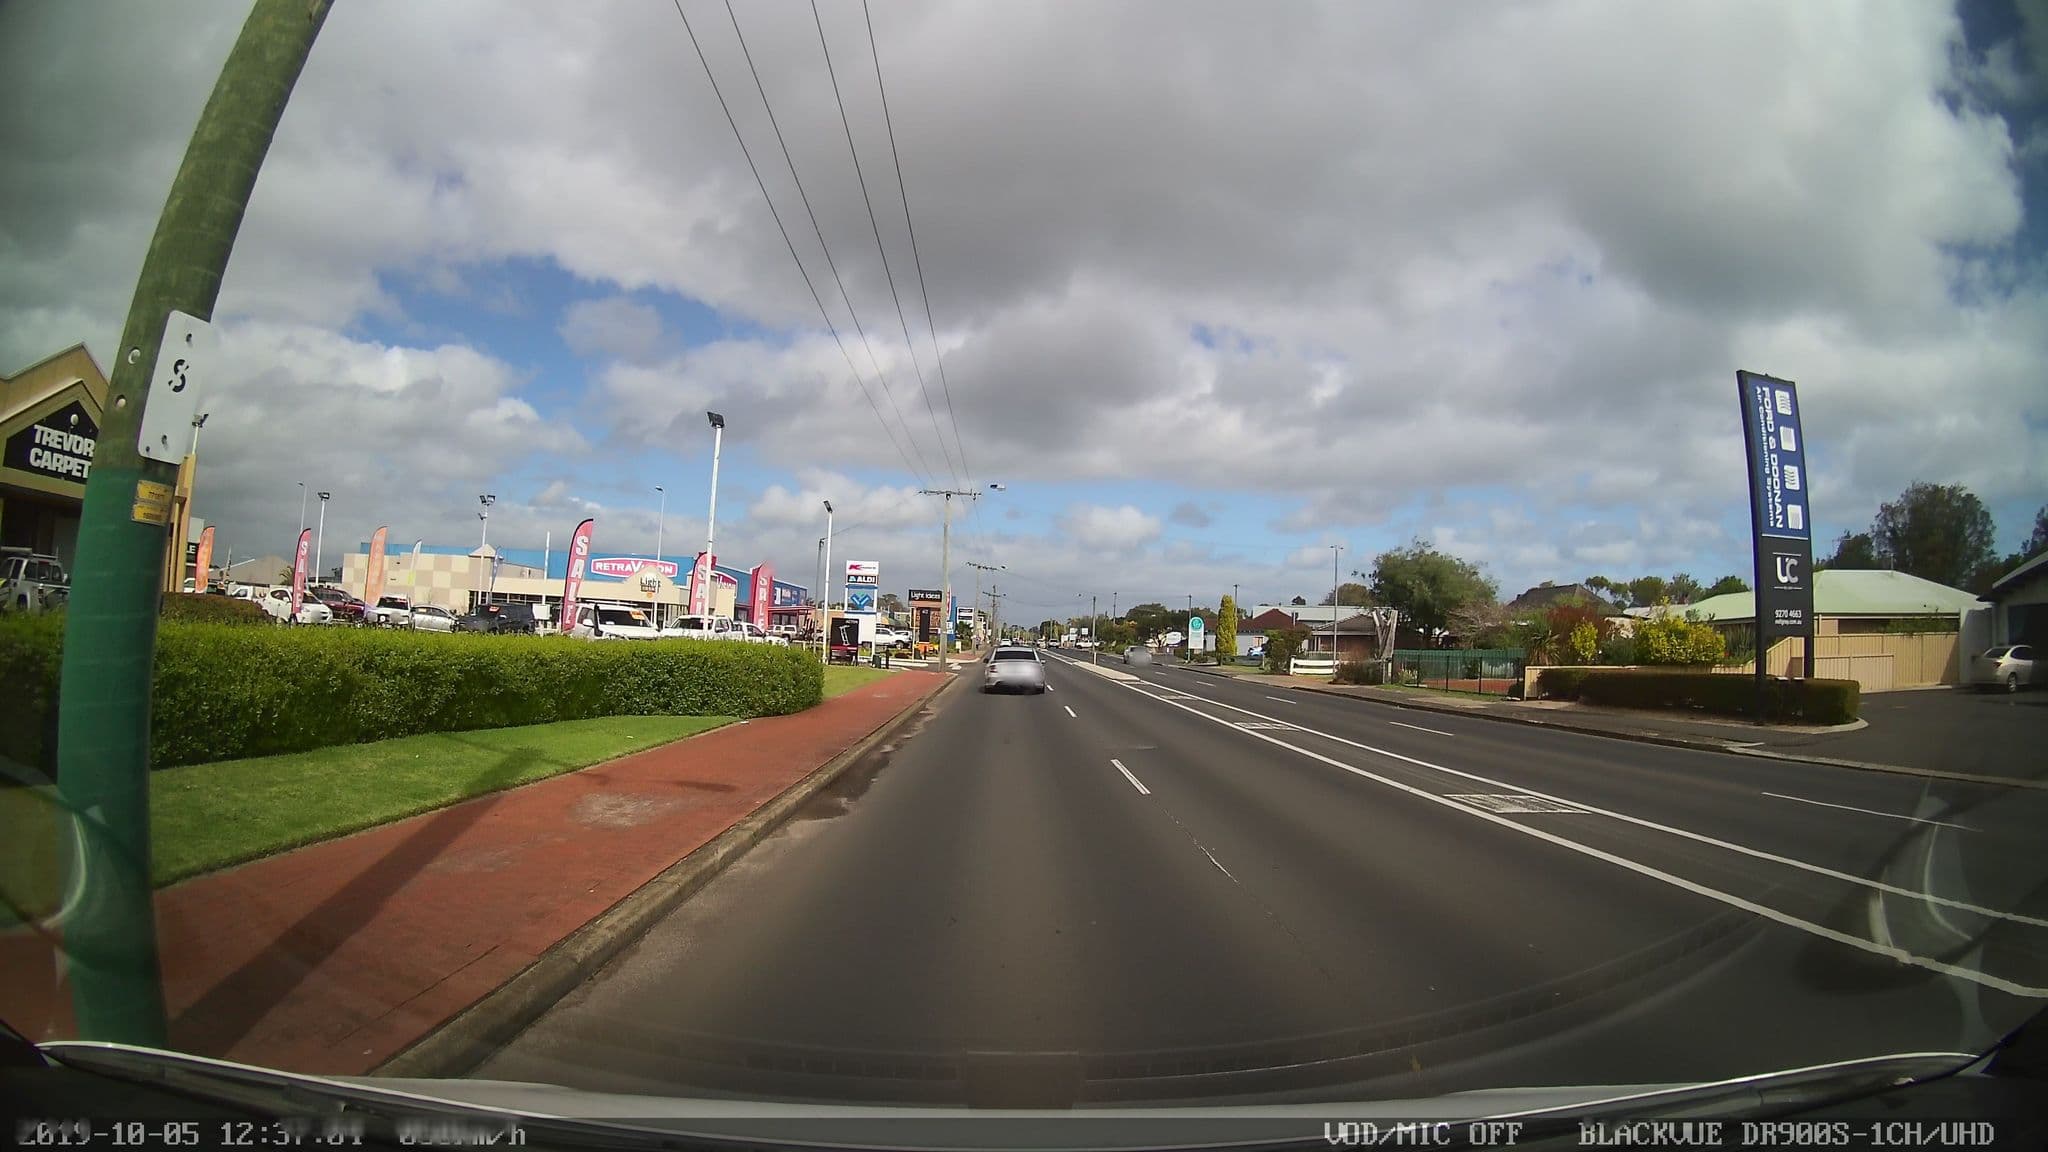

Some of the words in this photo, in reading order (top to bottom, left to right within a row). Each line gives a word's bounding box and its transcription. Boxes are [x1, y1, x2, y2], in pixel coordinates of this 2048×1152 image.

[33, 424, 96, 458] TREVOR
[1758, 406, 1769, 474] Conditioning
[1766, 477, 1775, 527] Systems
[1762, 387, 1774, 433] FORD
[1771, 453, 1784, 528] DOONAN
[295, 541, 308, 608] SALE
[565, 535, 589, 624] SALE
[696, 565, 708, 616] SAL
[911, 592, 924, 600] Light
